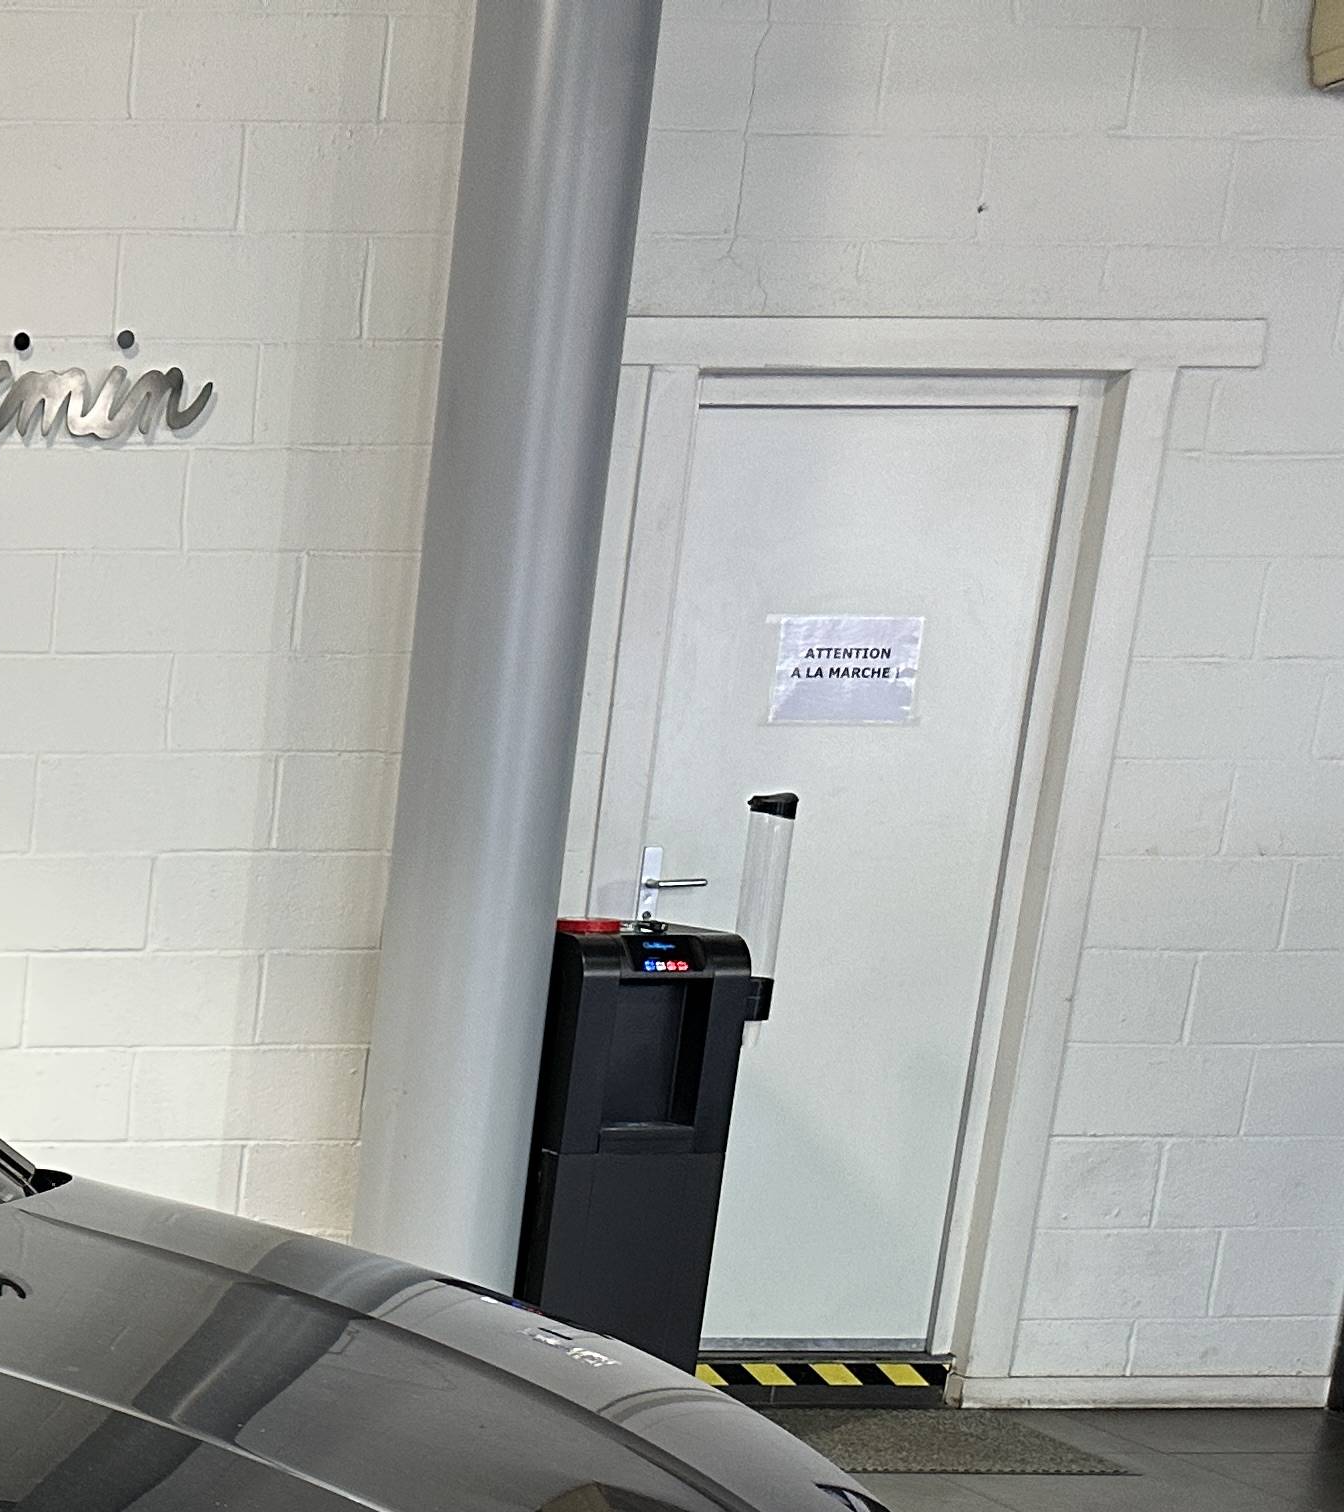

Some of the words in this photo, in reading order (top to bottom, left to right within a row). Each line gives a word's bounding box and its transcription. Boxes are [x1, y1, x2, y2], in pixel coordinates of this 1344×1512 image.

[804, 647, 892, 660] ATTENTION
[790, 667, 802, 679] A
[805, 667, 825, 679] LA
[828, 667, 891, 679] MARCHE
